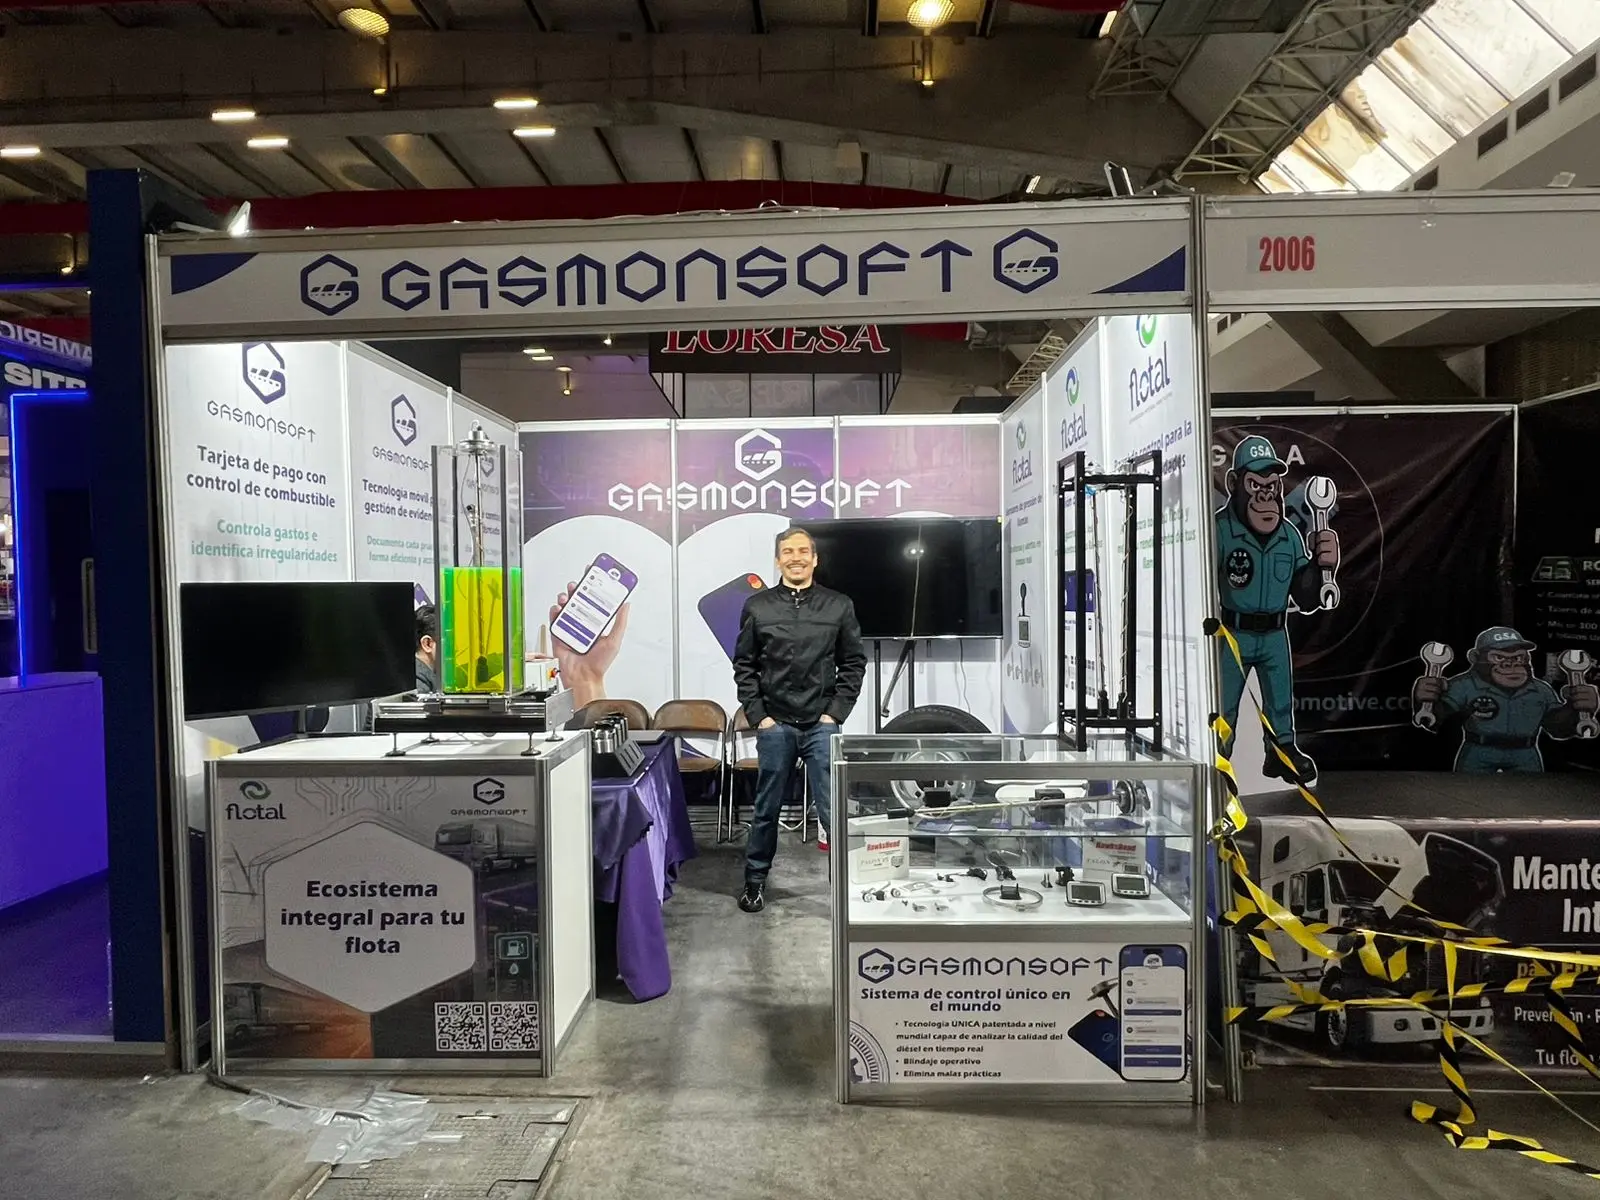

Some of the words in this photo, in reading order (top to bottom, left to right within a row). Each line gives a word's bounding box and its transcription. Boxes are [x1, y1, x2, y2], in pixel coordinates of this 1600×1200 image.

[1259, 236, 1315, 272] 2006
[381, 239, 973, 311] GASMONSOFT
[660, 324, 891, 354] LORESA
[1129, 340, 1170, 411] flotal
[207, 400, 316, 443] GASMONSOFT
[1061, 404, 1087, 452] flotal
[1165, 426, 1183, 452] para
[1184, 420, 1192, 437] la
[1250, 445, 1271, 457] GSA
[196, 445, 250, 471] Tarjeta
[253, 458, 270, 474] de
[272, 464, 304, 483] pago
[306, 470, 327, 485] con
[1012, 450, 1033, 486] flotal
[186, 472, 241, 494] control
[244, 481, 261, 497] de
[264, 485, 336, 508] combustible
[607, 477, 913, 511] GASMONSOFT
[364, 501, 396, 515] gestión
[398, 505, 408, 518] de
[216, 519, 272, 538] Controla
[274, 527, 310, 542] gastos
[312, 531, 318, 541] e
[191, 541, 254, 559] identifica
[256, 545, 338, 564] irregularidades
[1494, 632, 1518, 641] GSA
[225, 803, 286, 820] flotal
[307, 880, 438, 898] Ecosistema
[280, 908, 374, 931] integral
[380, 912, 434, 931] para
[441, 909, 465, 925] tu
[345, 936, 401, 954] flota
[897, 957, 1113, 976] GASMONSOFT
[861, 988, 919, 1000] Sistema
[924, 988, 943, 1000] de
[946, 988, 1001, 1000] control
[1005, 988, 1047, 1000] único
[1052, 991, 1071, 1000] en
[930, 1000, 943, 1011] el
[947, 1000, 1001, 1012] mundo
[982, 1021, 1026, 1029] patentada
[935, 1045, 965, 1053] tiempo
[1535, 1049, 1555, 1065] Tu
[904, 1058, 938, 1066] Blindaje
[940, 1058, 981, 1066] operativo
[963, 1070, 1001, 1079] prácticas
